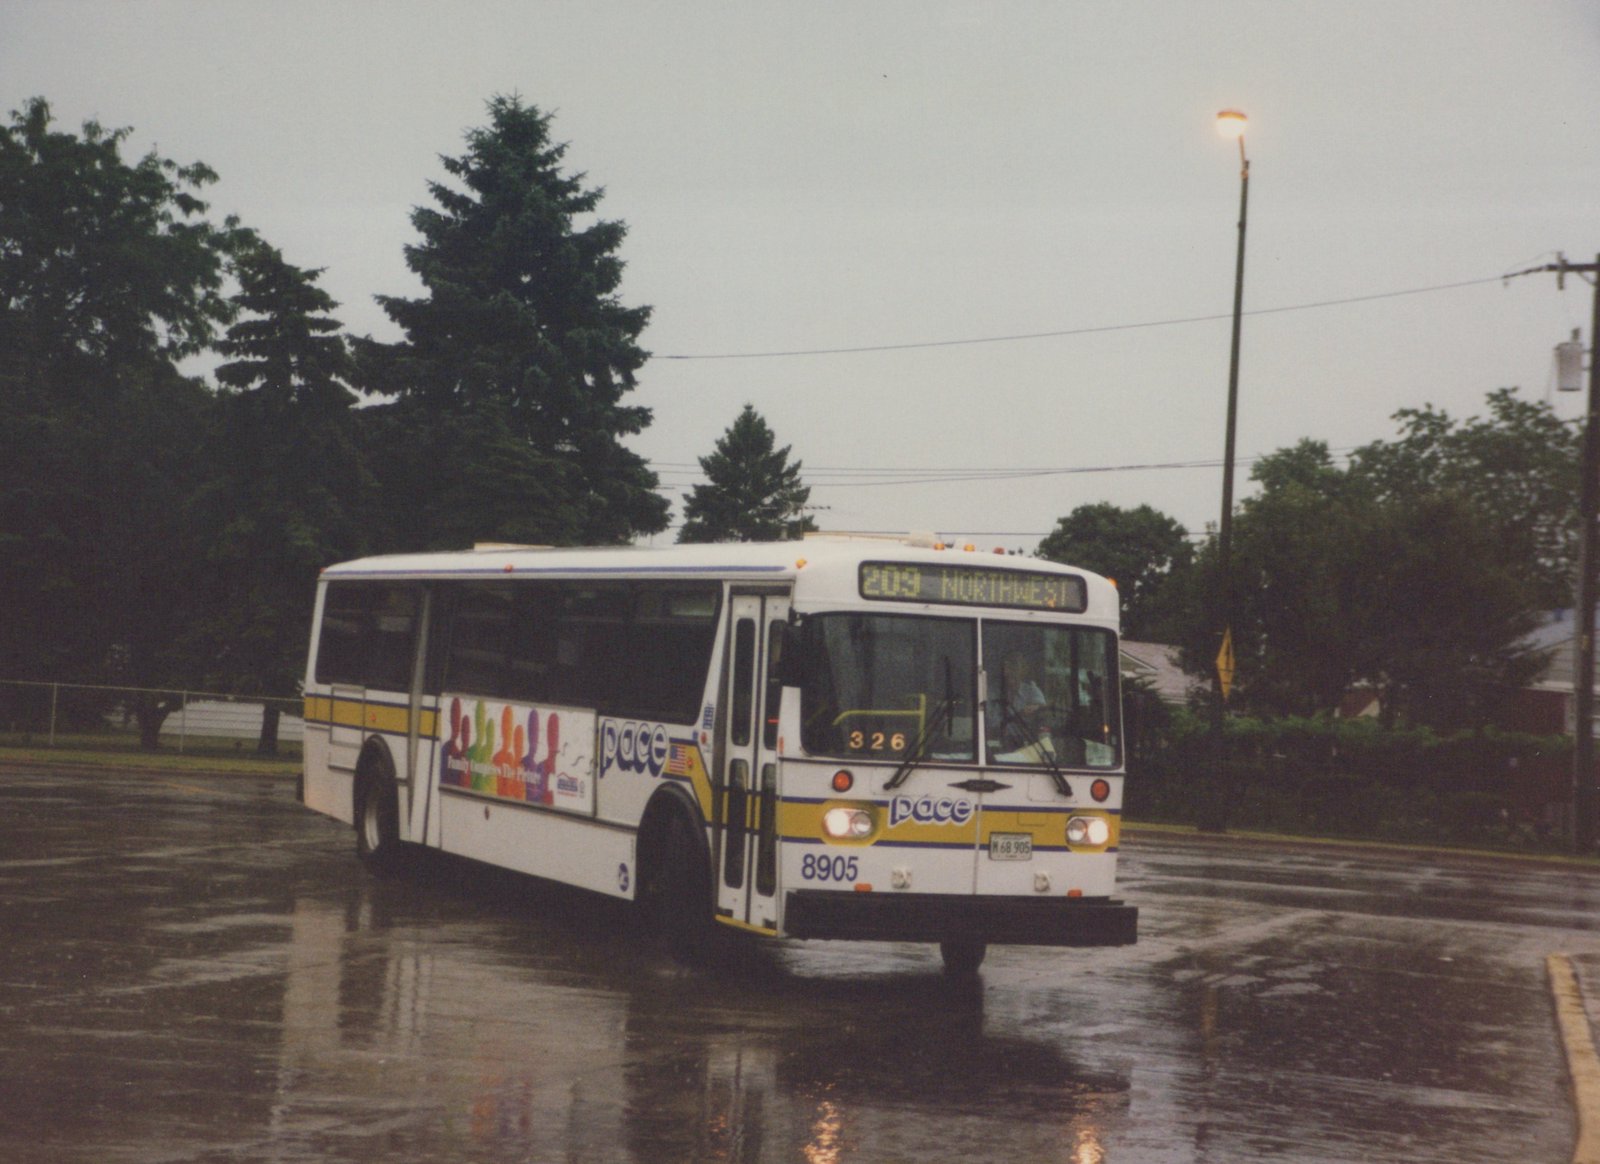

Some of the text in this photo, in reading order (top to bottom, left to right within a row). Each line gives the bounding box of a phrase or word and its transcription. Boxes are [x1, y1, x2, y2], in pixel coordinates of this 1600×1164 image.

[862, 565, 1069, 607] 209 NORTHWEST
[599, 718, 671, 779] pace
[888, 795, 975, 827] pace
[801, 853, 859, 882] 8905
